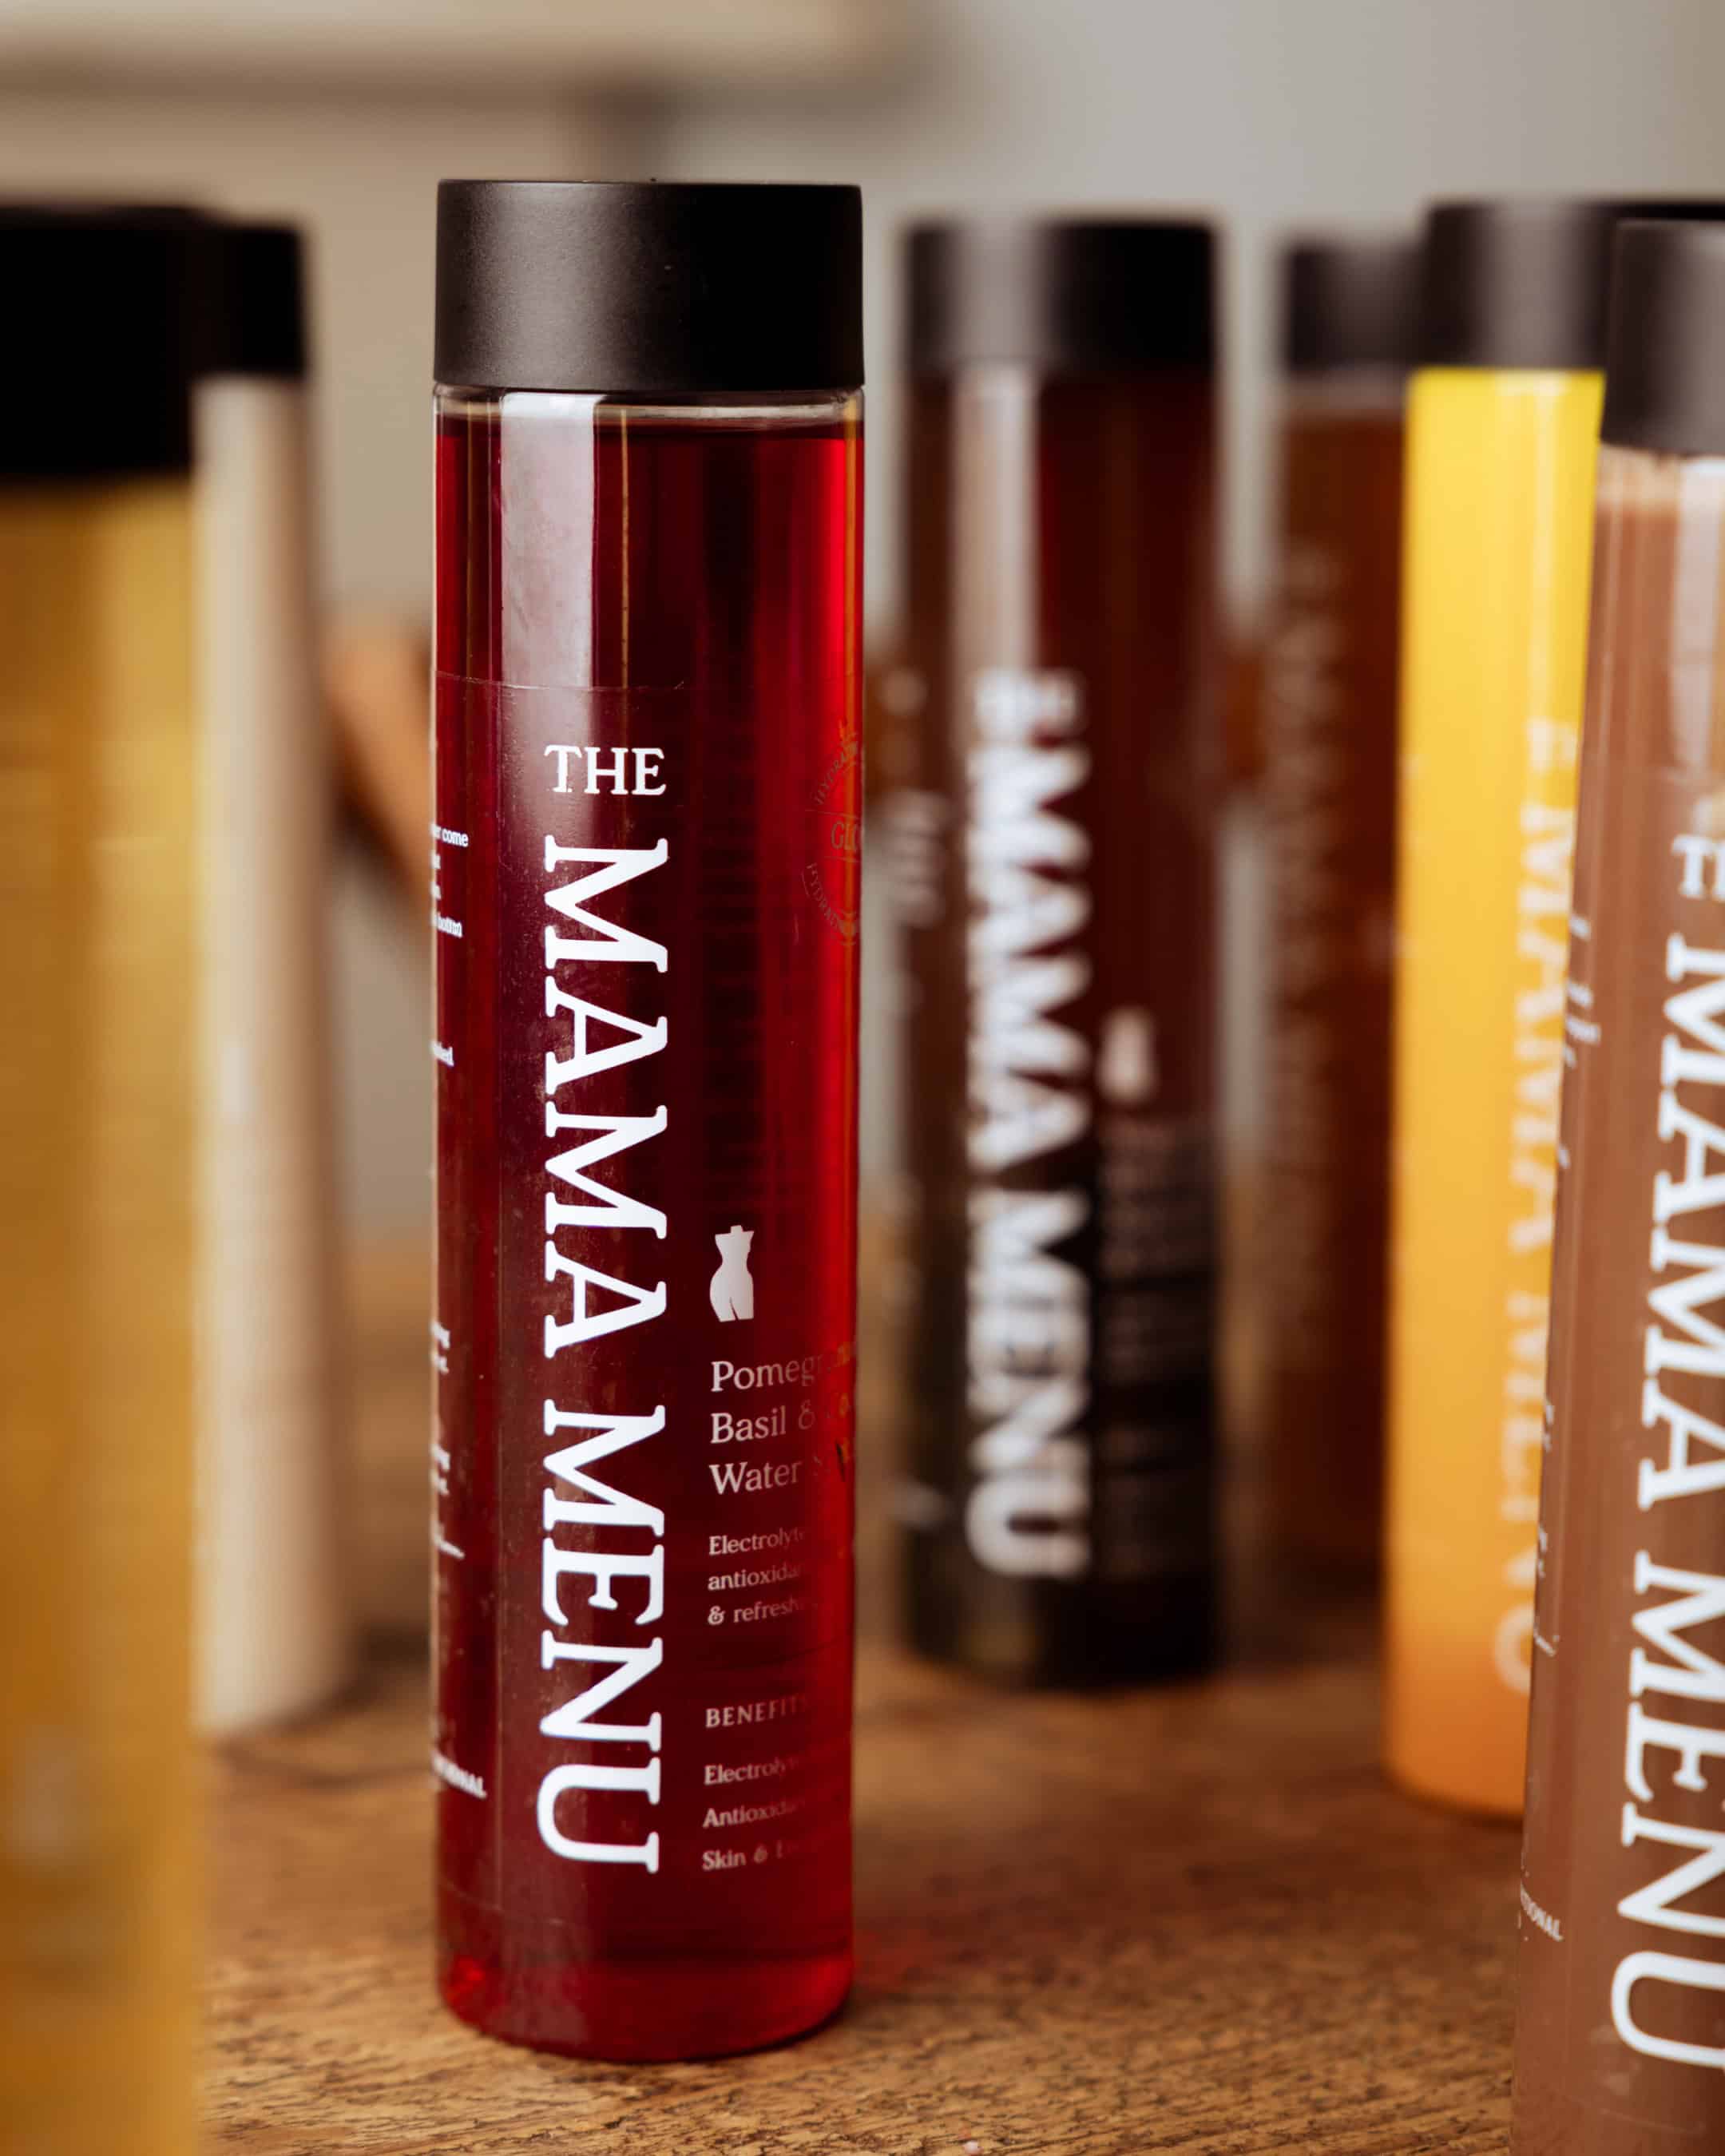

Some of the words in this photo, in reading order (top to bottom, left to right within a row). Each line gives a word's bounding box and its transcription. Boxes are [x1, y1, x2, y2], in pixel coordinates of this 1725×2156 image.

[544, 744, 666, 795] THE
[967, 744, 1090, 1171] MAMA
[544, 834, 668, 1358] MAMA
[710, 1405, 787, 1444] Basil
[967, 1190, 1090, 1578] MENU
[536, 1398, 666, 1875] MENU
[708, 1606, 725, 1626] &
[702, 1849, 747, 1872] Skin
[1609, 1549, 1725, 2072] MENU
